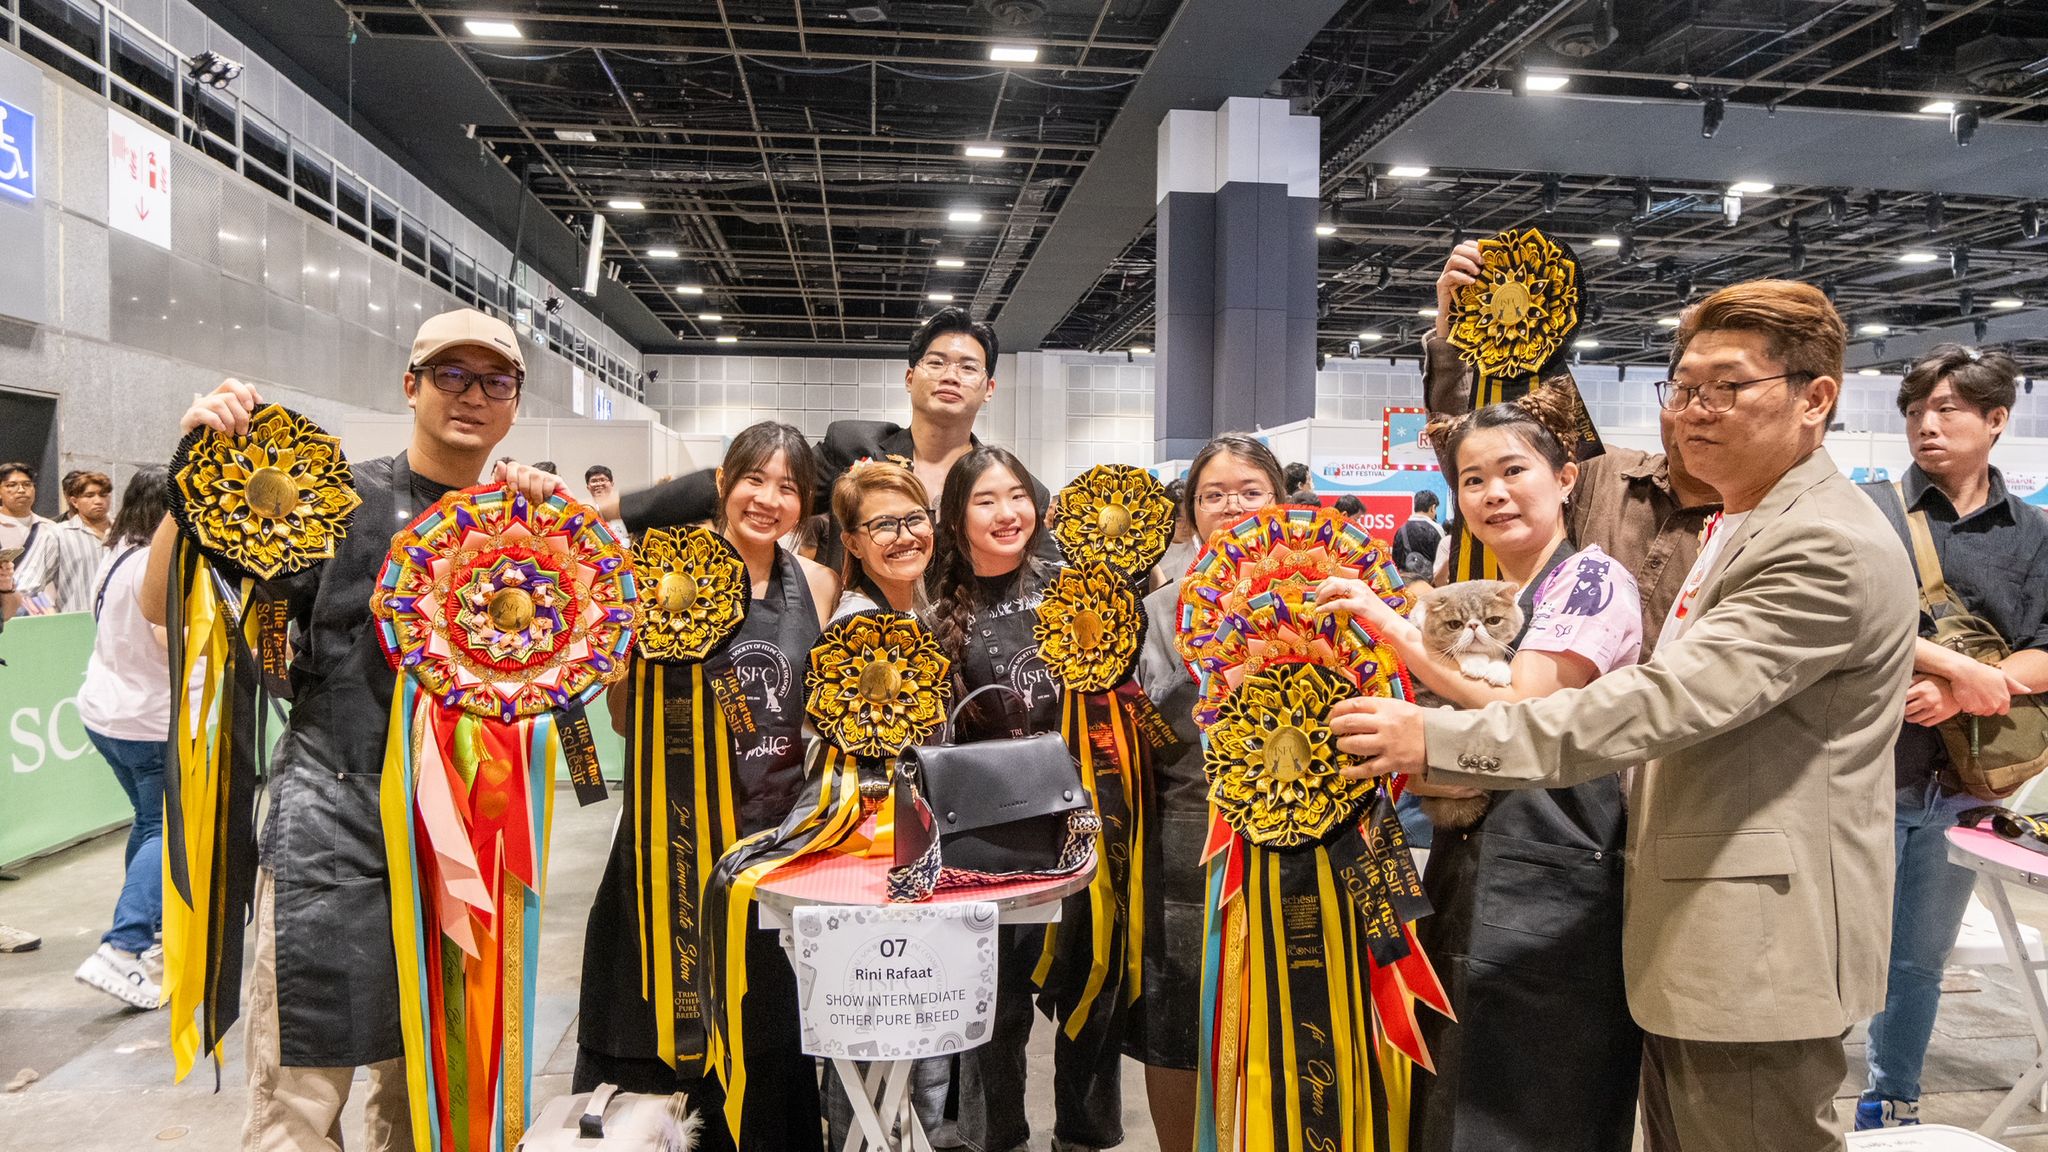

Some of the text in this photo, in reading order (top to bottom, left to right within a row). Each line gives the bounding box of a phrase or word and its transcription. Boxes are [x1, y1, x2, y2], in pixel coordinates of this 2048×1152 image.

[273, 599, 288, 628] Title
[736, 666, 775, 682] ISFC
[723, 668, 740, 694] Title
[735, 694, 757, 733] Partner
[1150, 712, 1179, 744] Partner
[574, 717, 600, 786] Title Partner
[1356, 850, 1381, 887] Title
[1383, 815, 1422, 897] Title Partner
[672, 800, 698, 985] 2nd Intermediate Show
[879, 938, 908, 958] 07
[855, 967, 933, 981] Rini Rafaat
[826, 989, 966, 1007] SHOW INTERMEDIATE
[830, 1010, 960, 1026] OTHER PURE BREED
[1301, 1021, 1326, 1048] 1st
[1301, 1060, 1335, 1116] Open
